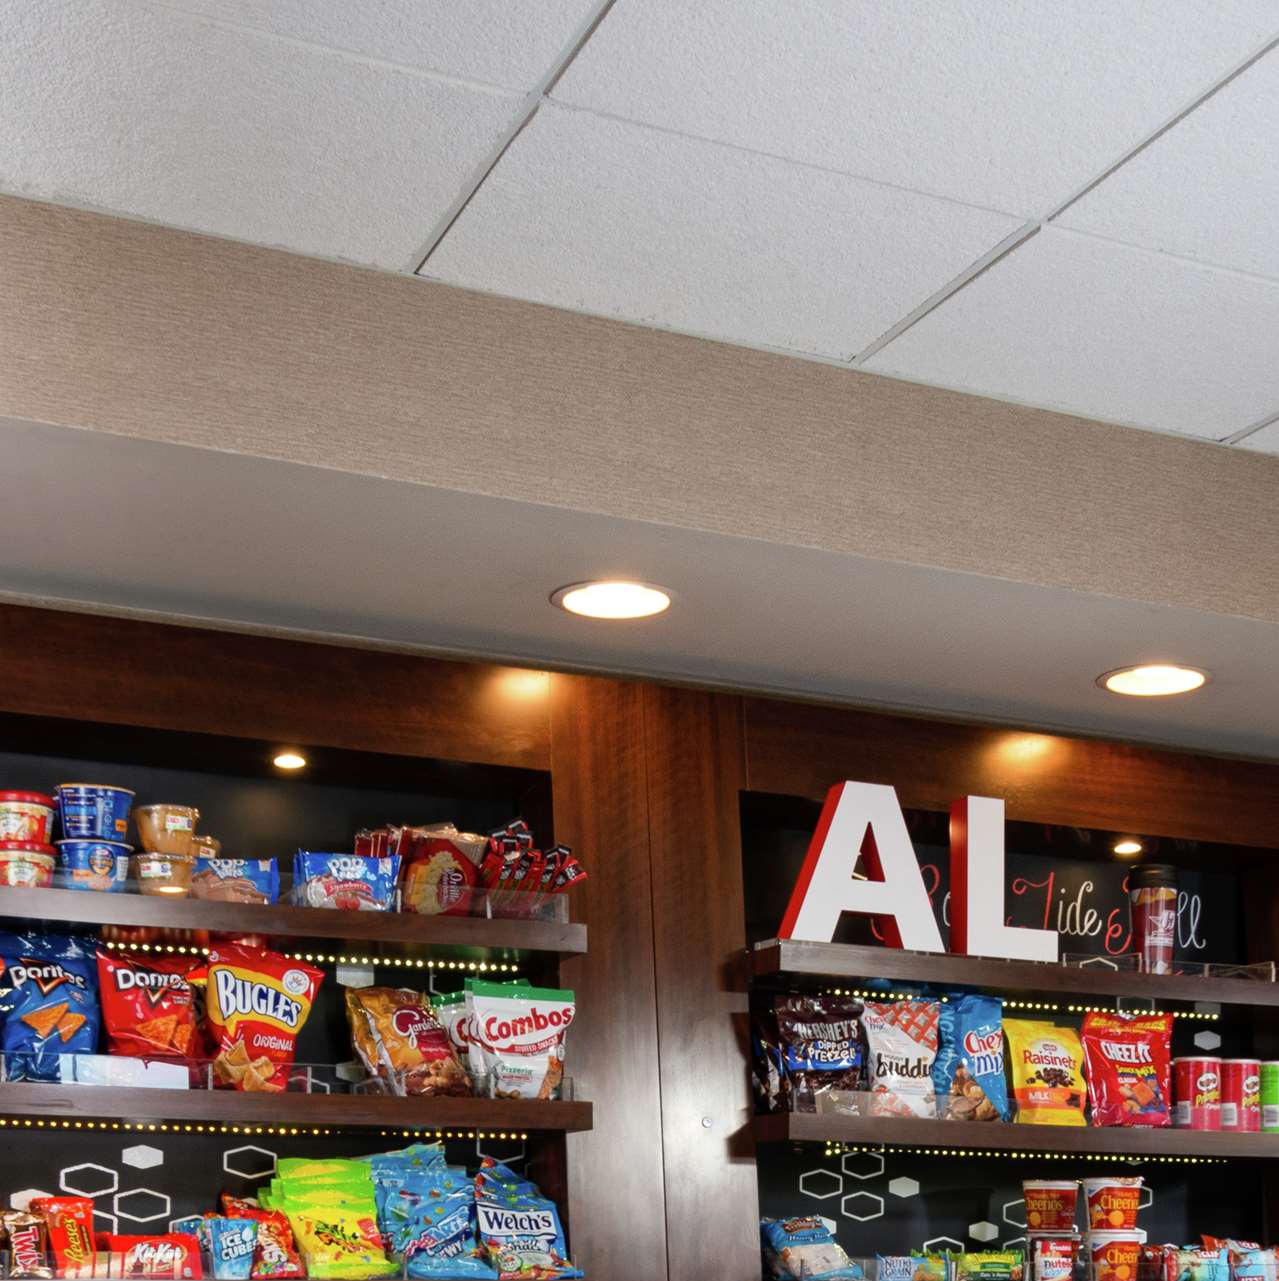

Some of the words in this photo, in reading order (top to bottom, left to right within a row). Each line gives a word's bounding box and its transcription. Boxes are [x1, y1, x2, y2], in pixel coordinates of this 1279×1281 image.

[782, 780, 1060, 964] AL
[1011, 870, 1103, 938] Tide
[215, 969, 302, 1028] BUGLES
[485, 1007, 573, 1042] Combos
[798, 1019, 858, 1040] HERSHEY'S
[252, 1033, 294, 1051] ORIGINAL
[817, 1040, 849, 1050] DIPPED
[500, 1064, 534, 1076] Pizzeria
[1023, 1049, 1078, 1070] Raisinets
[482, 1209, 552, 1231] Welch's
[220, 1233, 242, 1249] ICE
